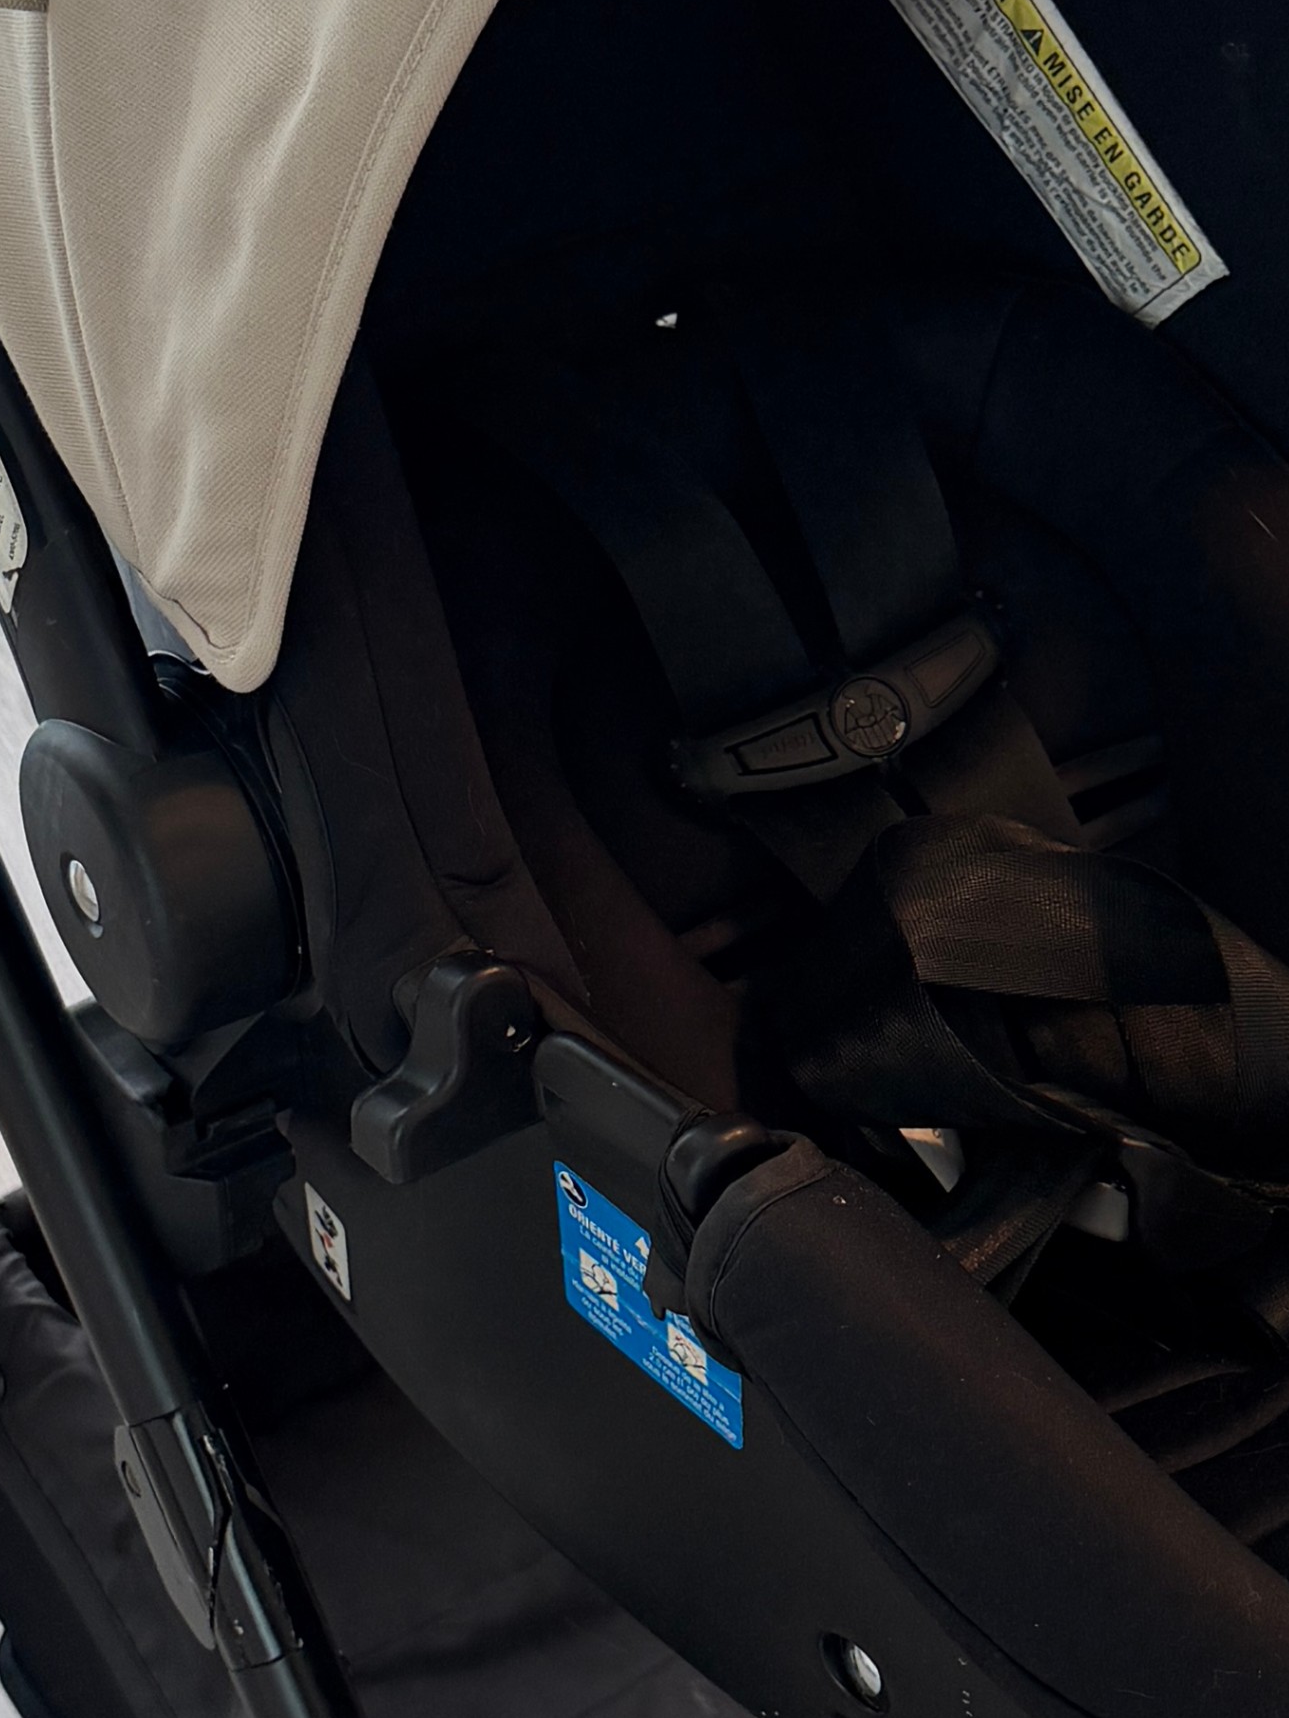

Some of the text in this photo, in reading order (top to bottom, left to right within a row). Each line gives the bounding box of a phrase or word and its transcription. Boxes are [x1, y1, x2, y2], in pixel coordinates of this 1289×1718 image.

[1040, 50, 1097, 122] MISE
[1092, 125, 1126, 164] EN
[1120, 168, 1192, 263] GARDE
[568, 1203, 620, 1255] ORIENTÉ
[623, 1248, 647, 1276] VER
